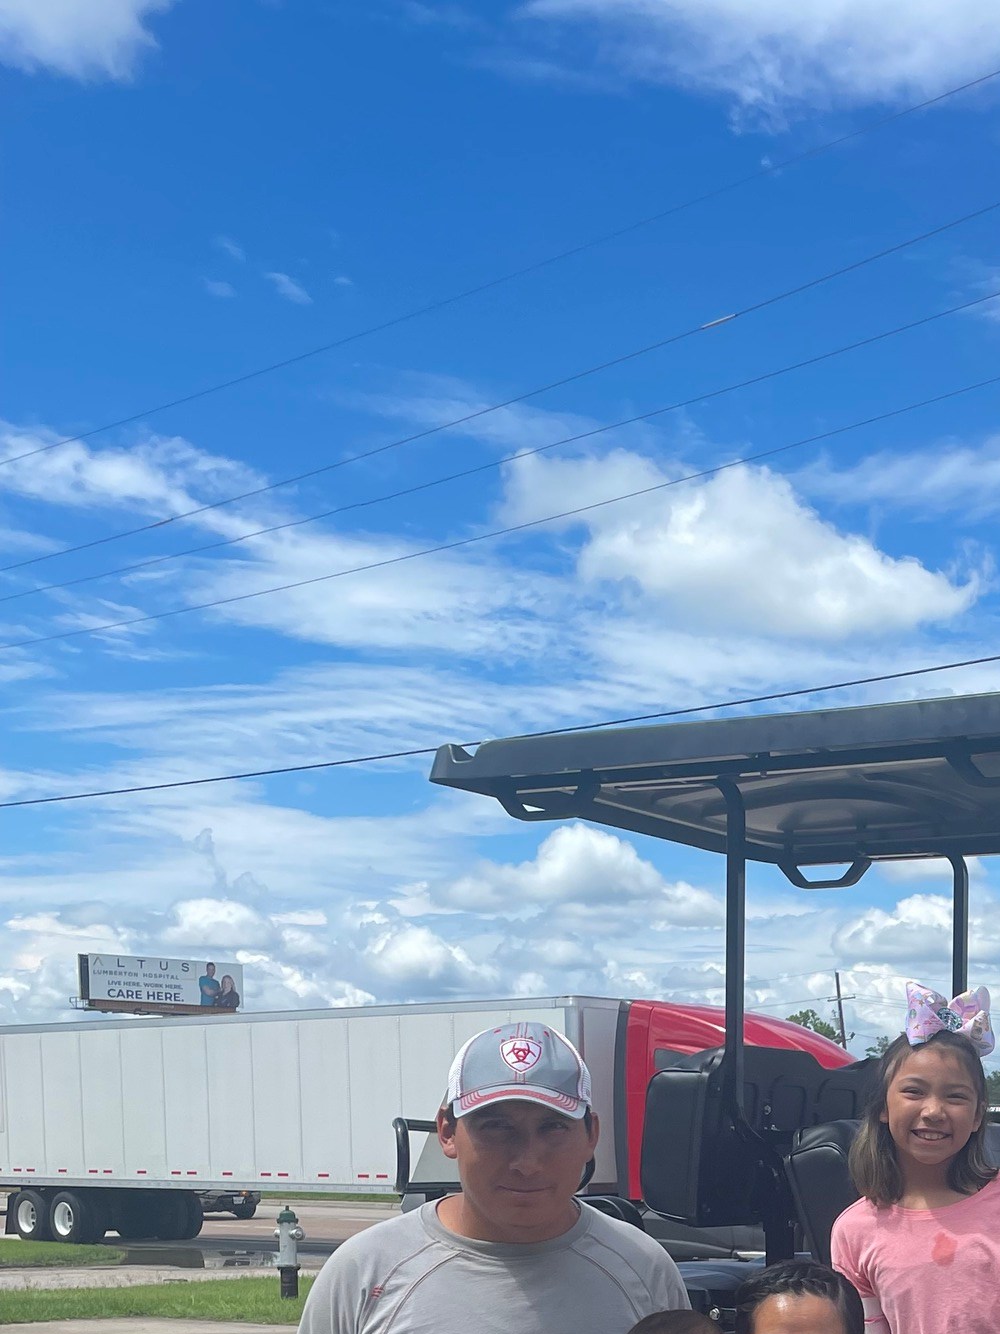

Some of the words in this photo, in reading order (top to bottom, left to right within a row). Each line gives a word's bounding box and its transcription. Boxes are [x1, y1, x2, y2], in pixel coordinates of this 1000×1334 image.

[93, 956, 190, 973] ALTUS
[93, 969, 139, 978] LUMBERTON
[142, 971, 180, 981] HOSPITAL
[107, 988, 143, 1000] CARE
[146, 990, 185, 1003] HERE.
